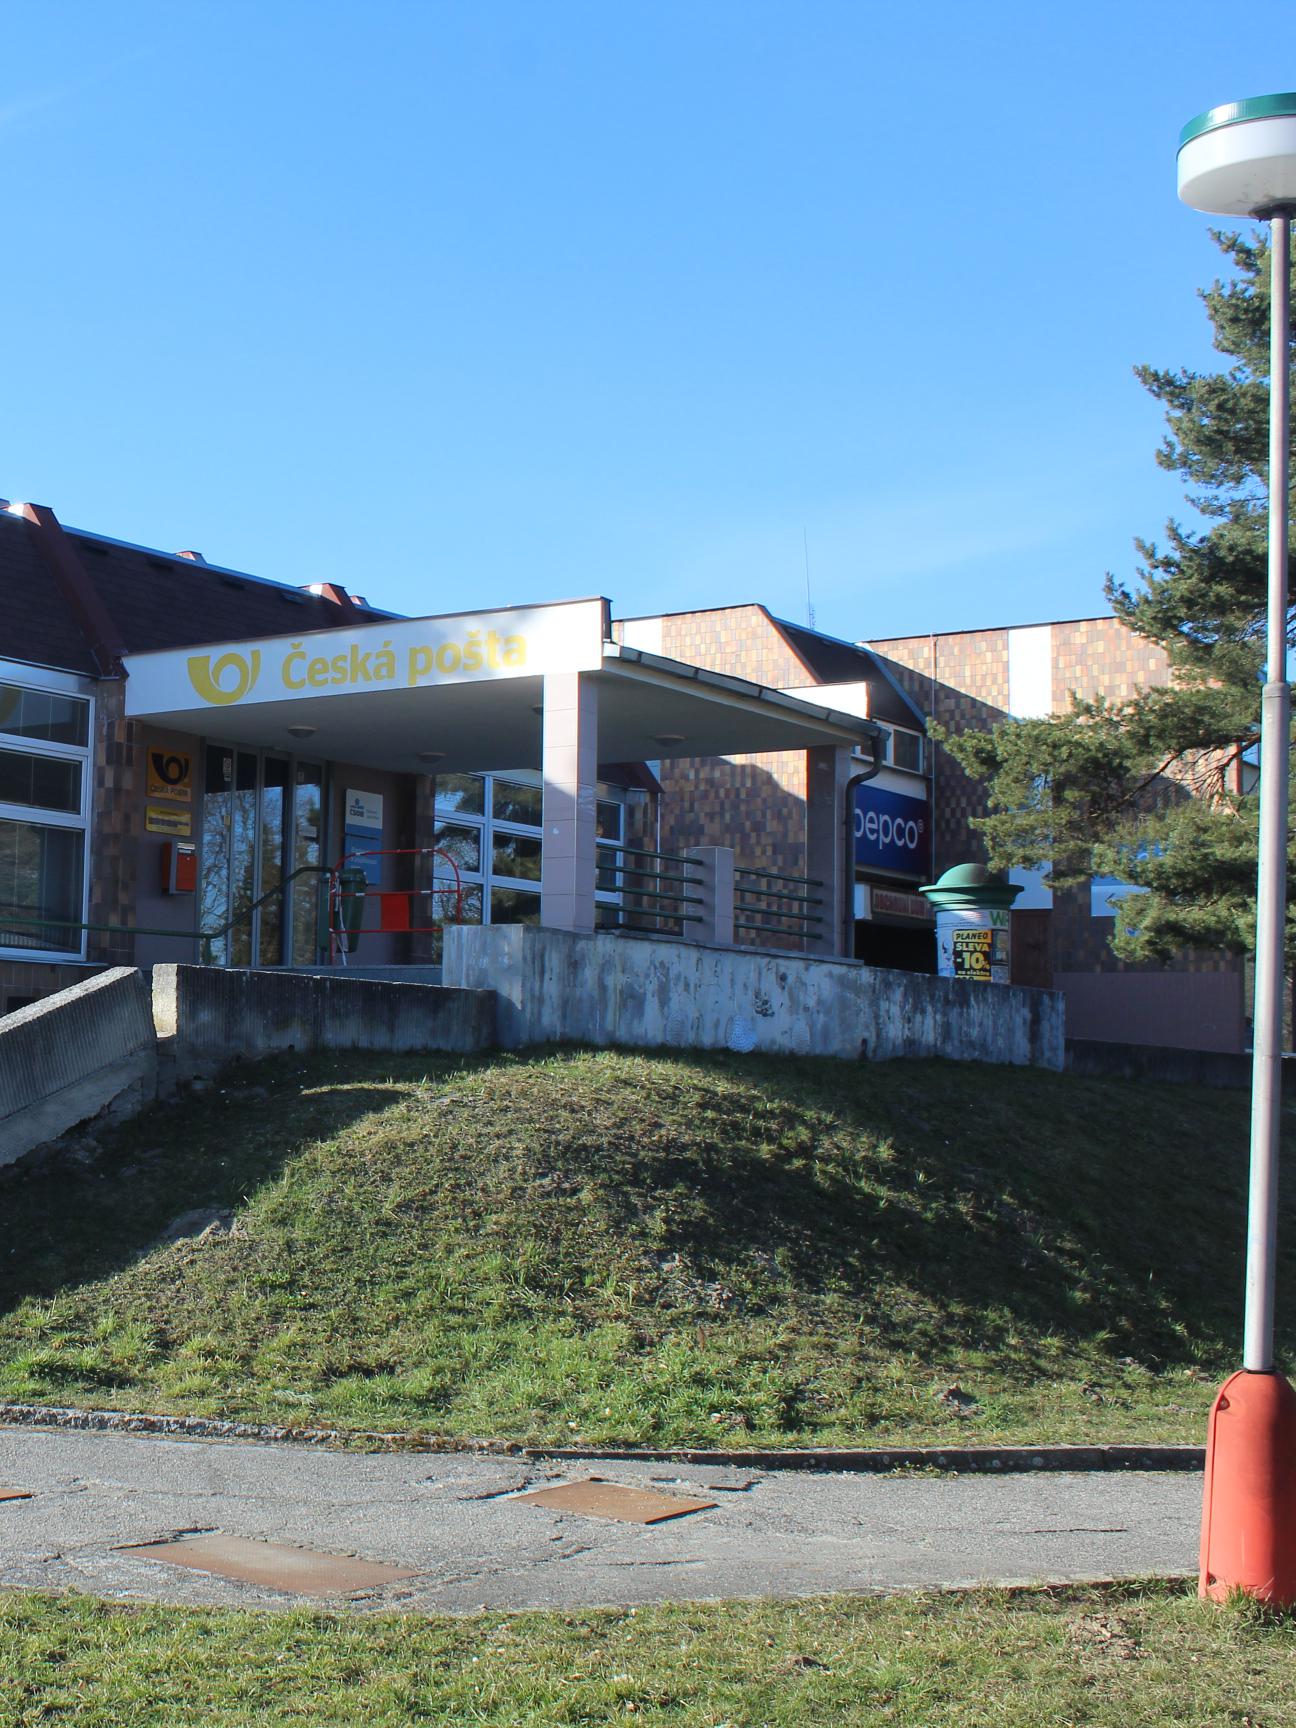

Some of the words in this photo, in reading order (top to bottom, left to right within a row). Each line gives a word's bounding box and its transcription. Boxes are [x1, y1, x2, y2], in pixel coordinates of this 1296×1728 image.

[282, 640, 395, 690] Česká
[409, 631, 527, 686] pošta
[956, 932, 988, 941] PLANEO
[956, 942, 990, 951] SLEVA
[956, 952, 990, 969] -10%
